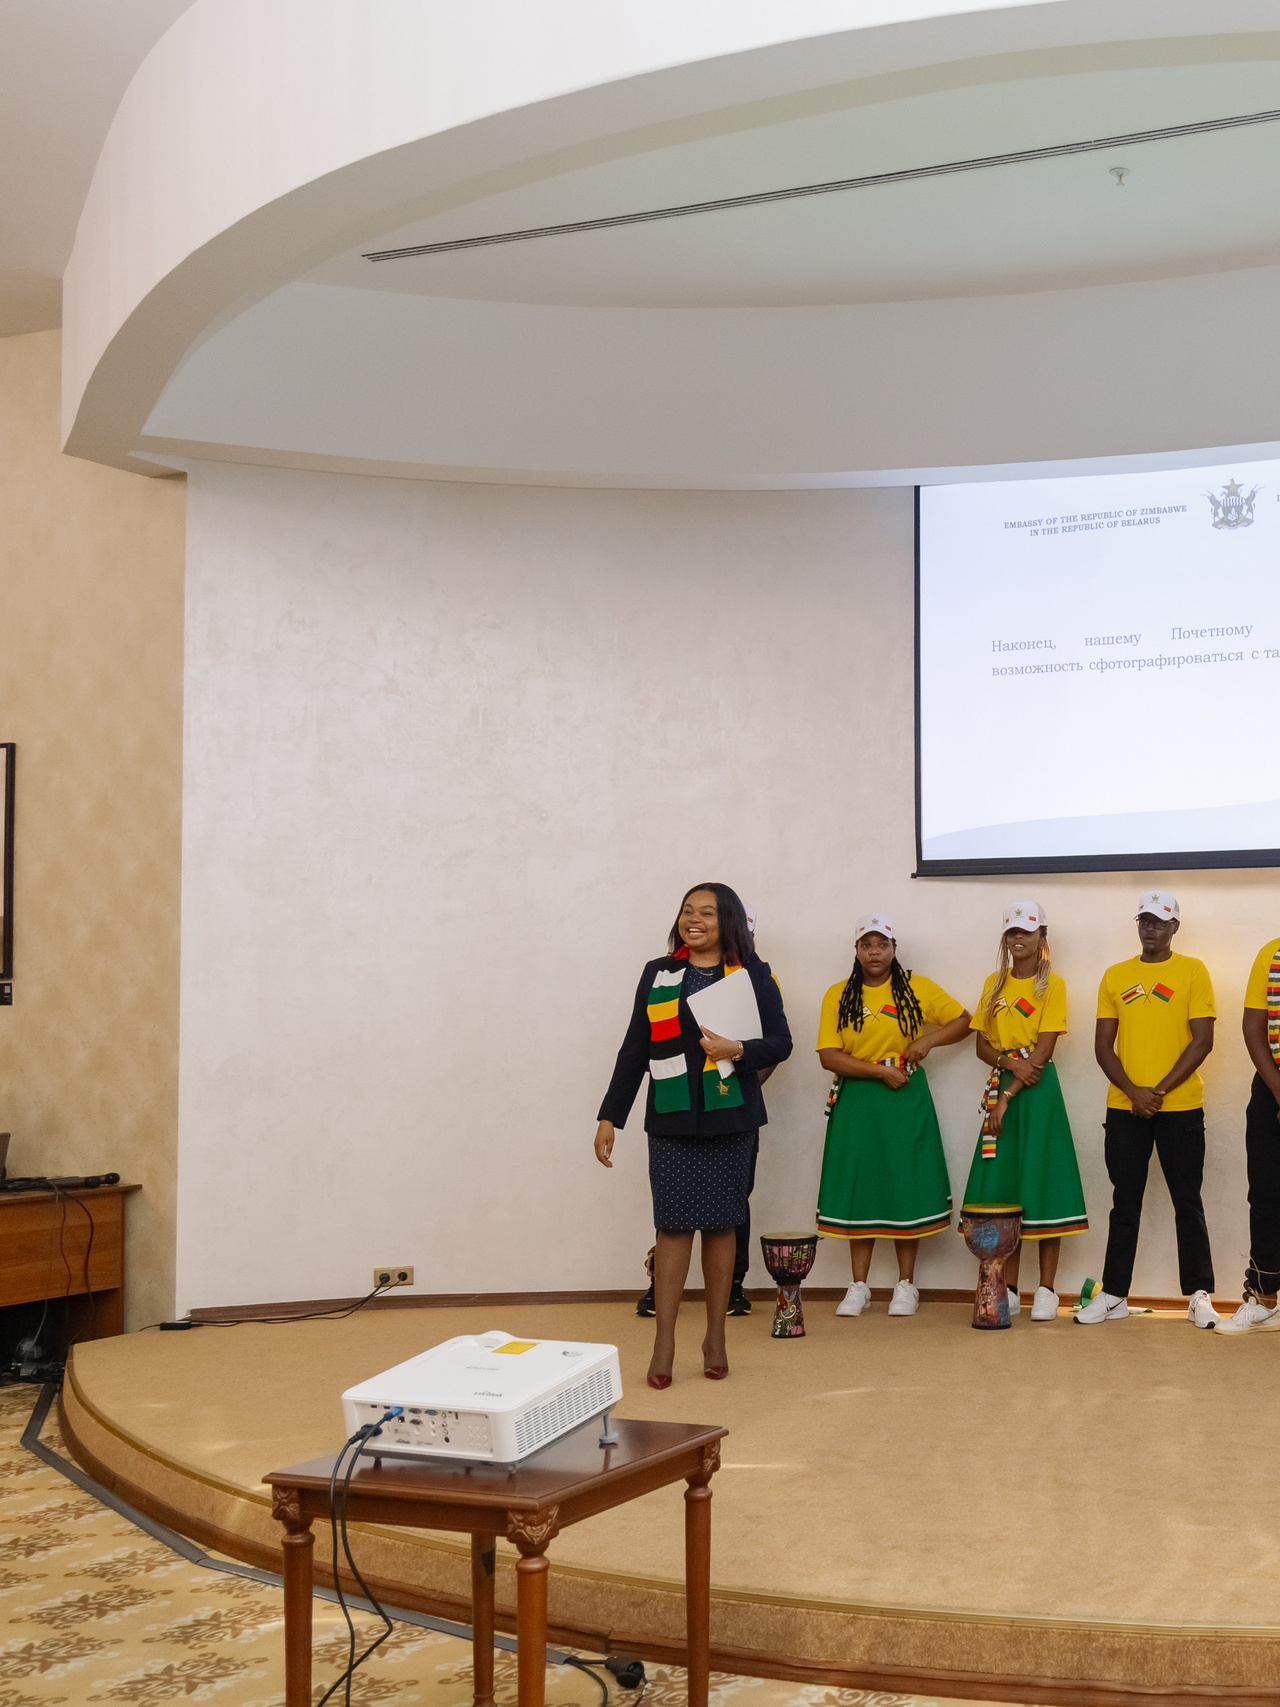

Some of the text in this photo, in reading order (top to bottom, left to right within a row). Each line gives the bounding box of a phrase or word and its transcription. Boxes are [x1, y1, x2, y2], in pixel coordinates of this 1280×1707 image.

[1004, 520, 1043, 529] EMBASSY
[1061, 515, 1078, 524] THE
[1081, 511, 1123, 522] REPUBLIC
[1126, 509, 1138, 517] OF
[1140, 505, 1187, 515] ZIMBABWE
[1042, 527, 1059, 535] THE
[1061, 523, 1104, 533] REPUBLIC
[1121, 517, 1160, 527] BELARUS
[992, 639, 1056, 651] Наконец,
[1085, 634, 1141, 646] нашему
[1171, 624, 1253, 640] Почетному
[992, 662, 1084, 676] возможность
[1089, 651, 1244, 673] сфотографироваться
[1251, 650, 1259, 659] с
